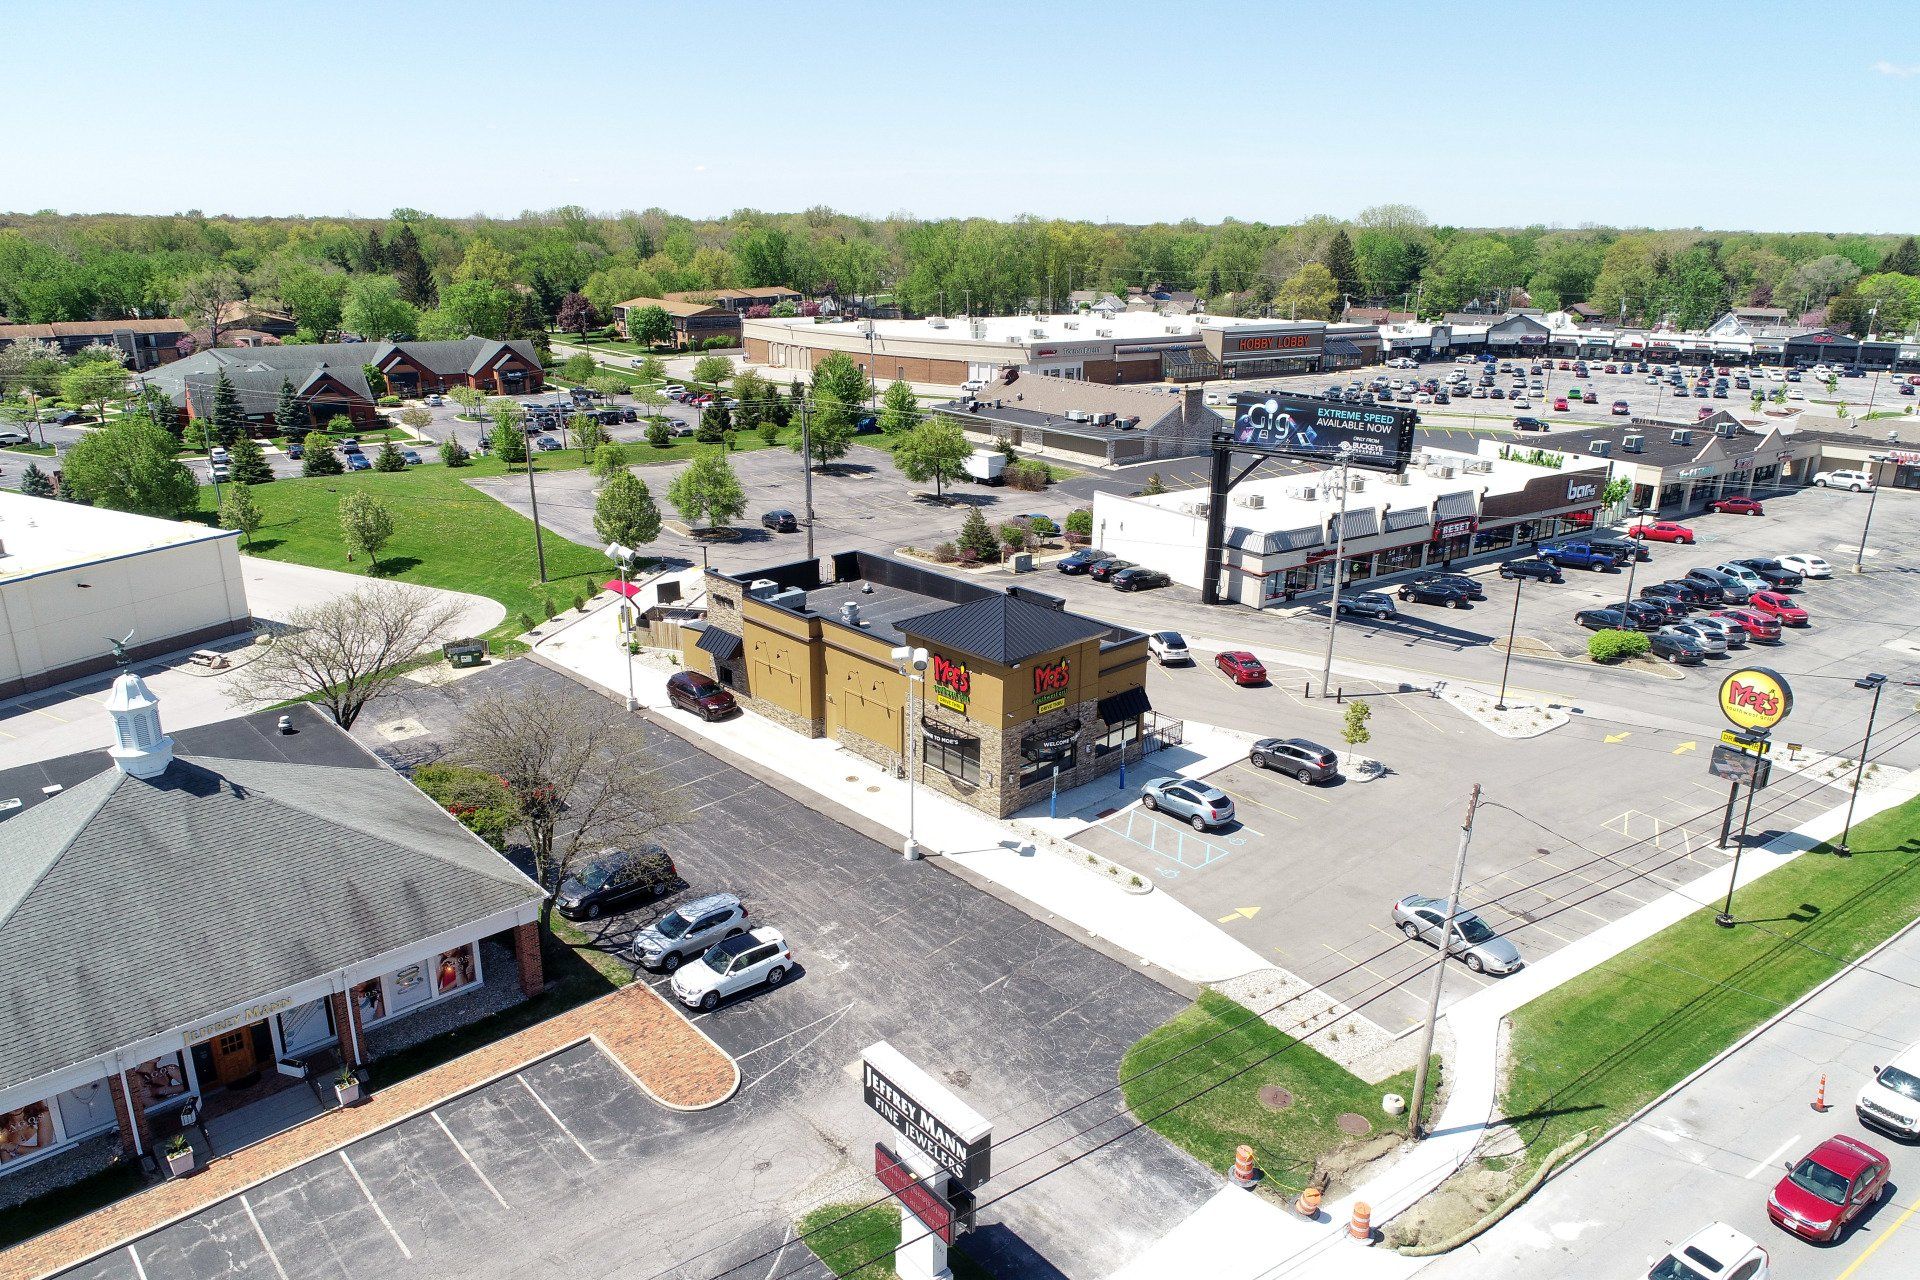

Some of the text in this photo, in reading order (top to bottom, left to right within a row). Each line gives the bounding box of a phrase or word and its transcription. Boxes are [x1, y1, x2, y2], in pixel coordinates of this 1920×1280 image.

[1239, 337, 1273, 350] HOBBY
[1277, 334, 1310, 348] LOBBY
[1248, 399, 1291, 439] Gig
[1317, 408, 1395, 424] EXTREME SPEED
[1316, 418, 1392, 434] AVAILABLE NOW
[1352, 442, 1384, 451] BUCKEYE
[1442, 523, 1470, 535] RESET
[934, 734, 942, 742] TO
[941, 737, 959, 745] MOE'S
[1043, 737, 1070, 748] WELCOME
[875, 1096, 964, 1179] FINE JEWELERS
